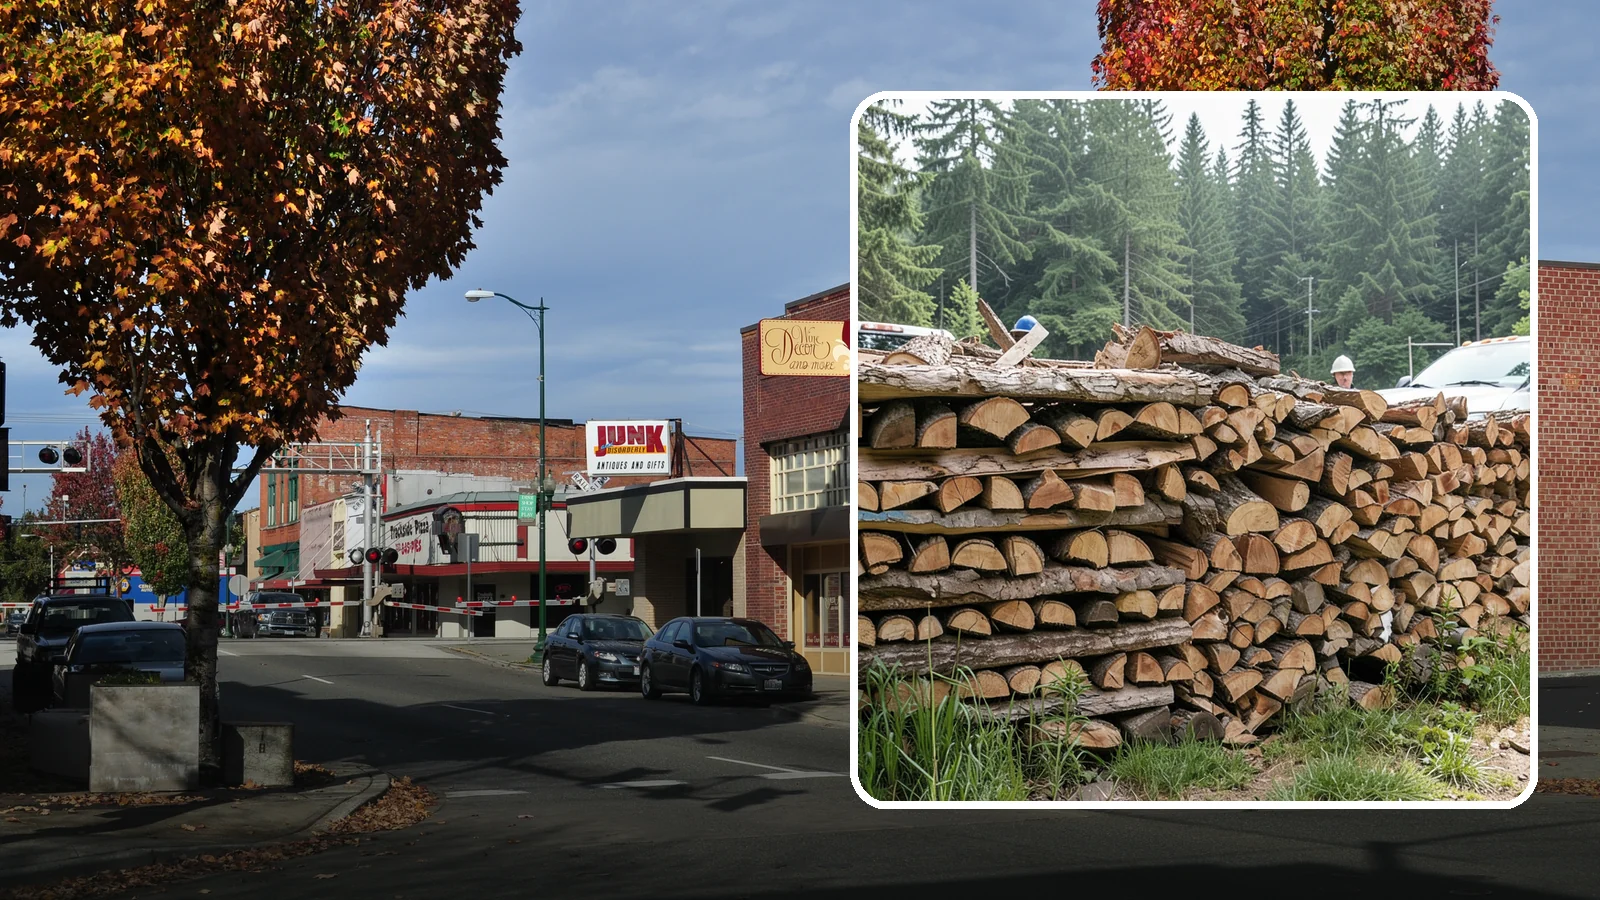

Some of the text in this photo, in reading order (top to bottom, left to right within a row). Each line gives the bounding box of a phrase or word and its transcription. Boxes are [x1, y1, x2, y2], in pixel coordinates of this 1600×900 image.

[764, 327, 831, 365] Decor
[595, 425, 665, 457] JUNK
[607, 446, 646, 454] DISORDERLY
[596, 460, 665, 470] ANTIQUES AND GIFTS
[590, 476, 608, 492] SING
[390, 519, 429, 540] Trackside Pizza
